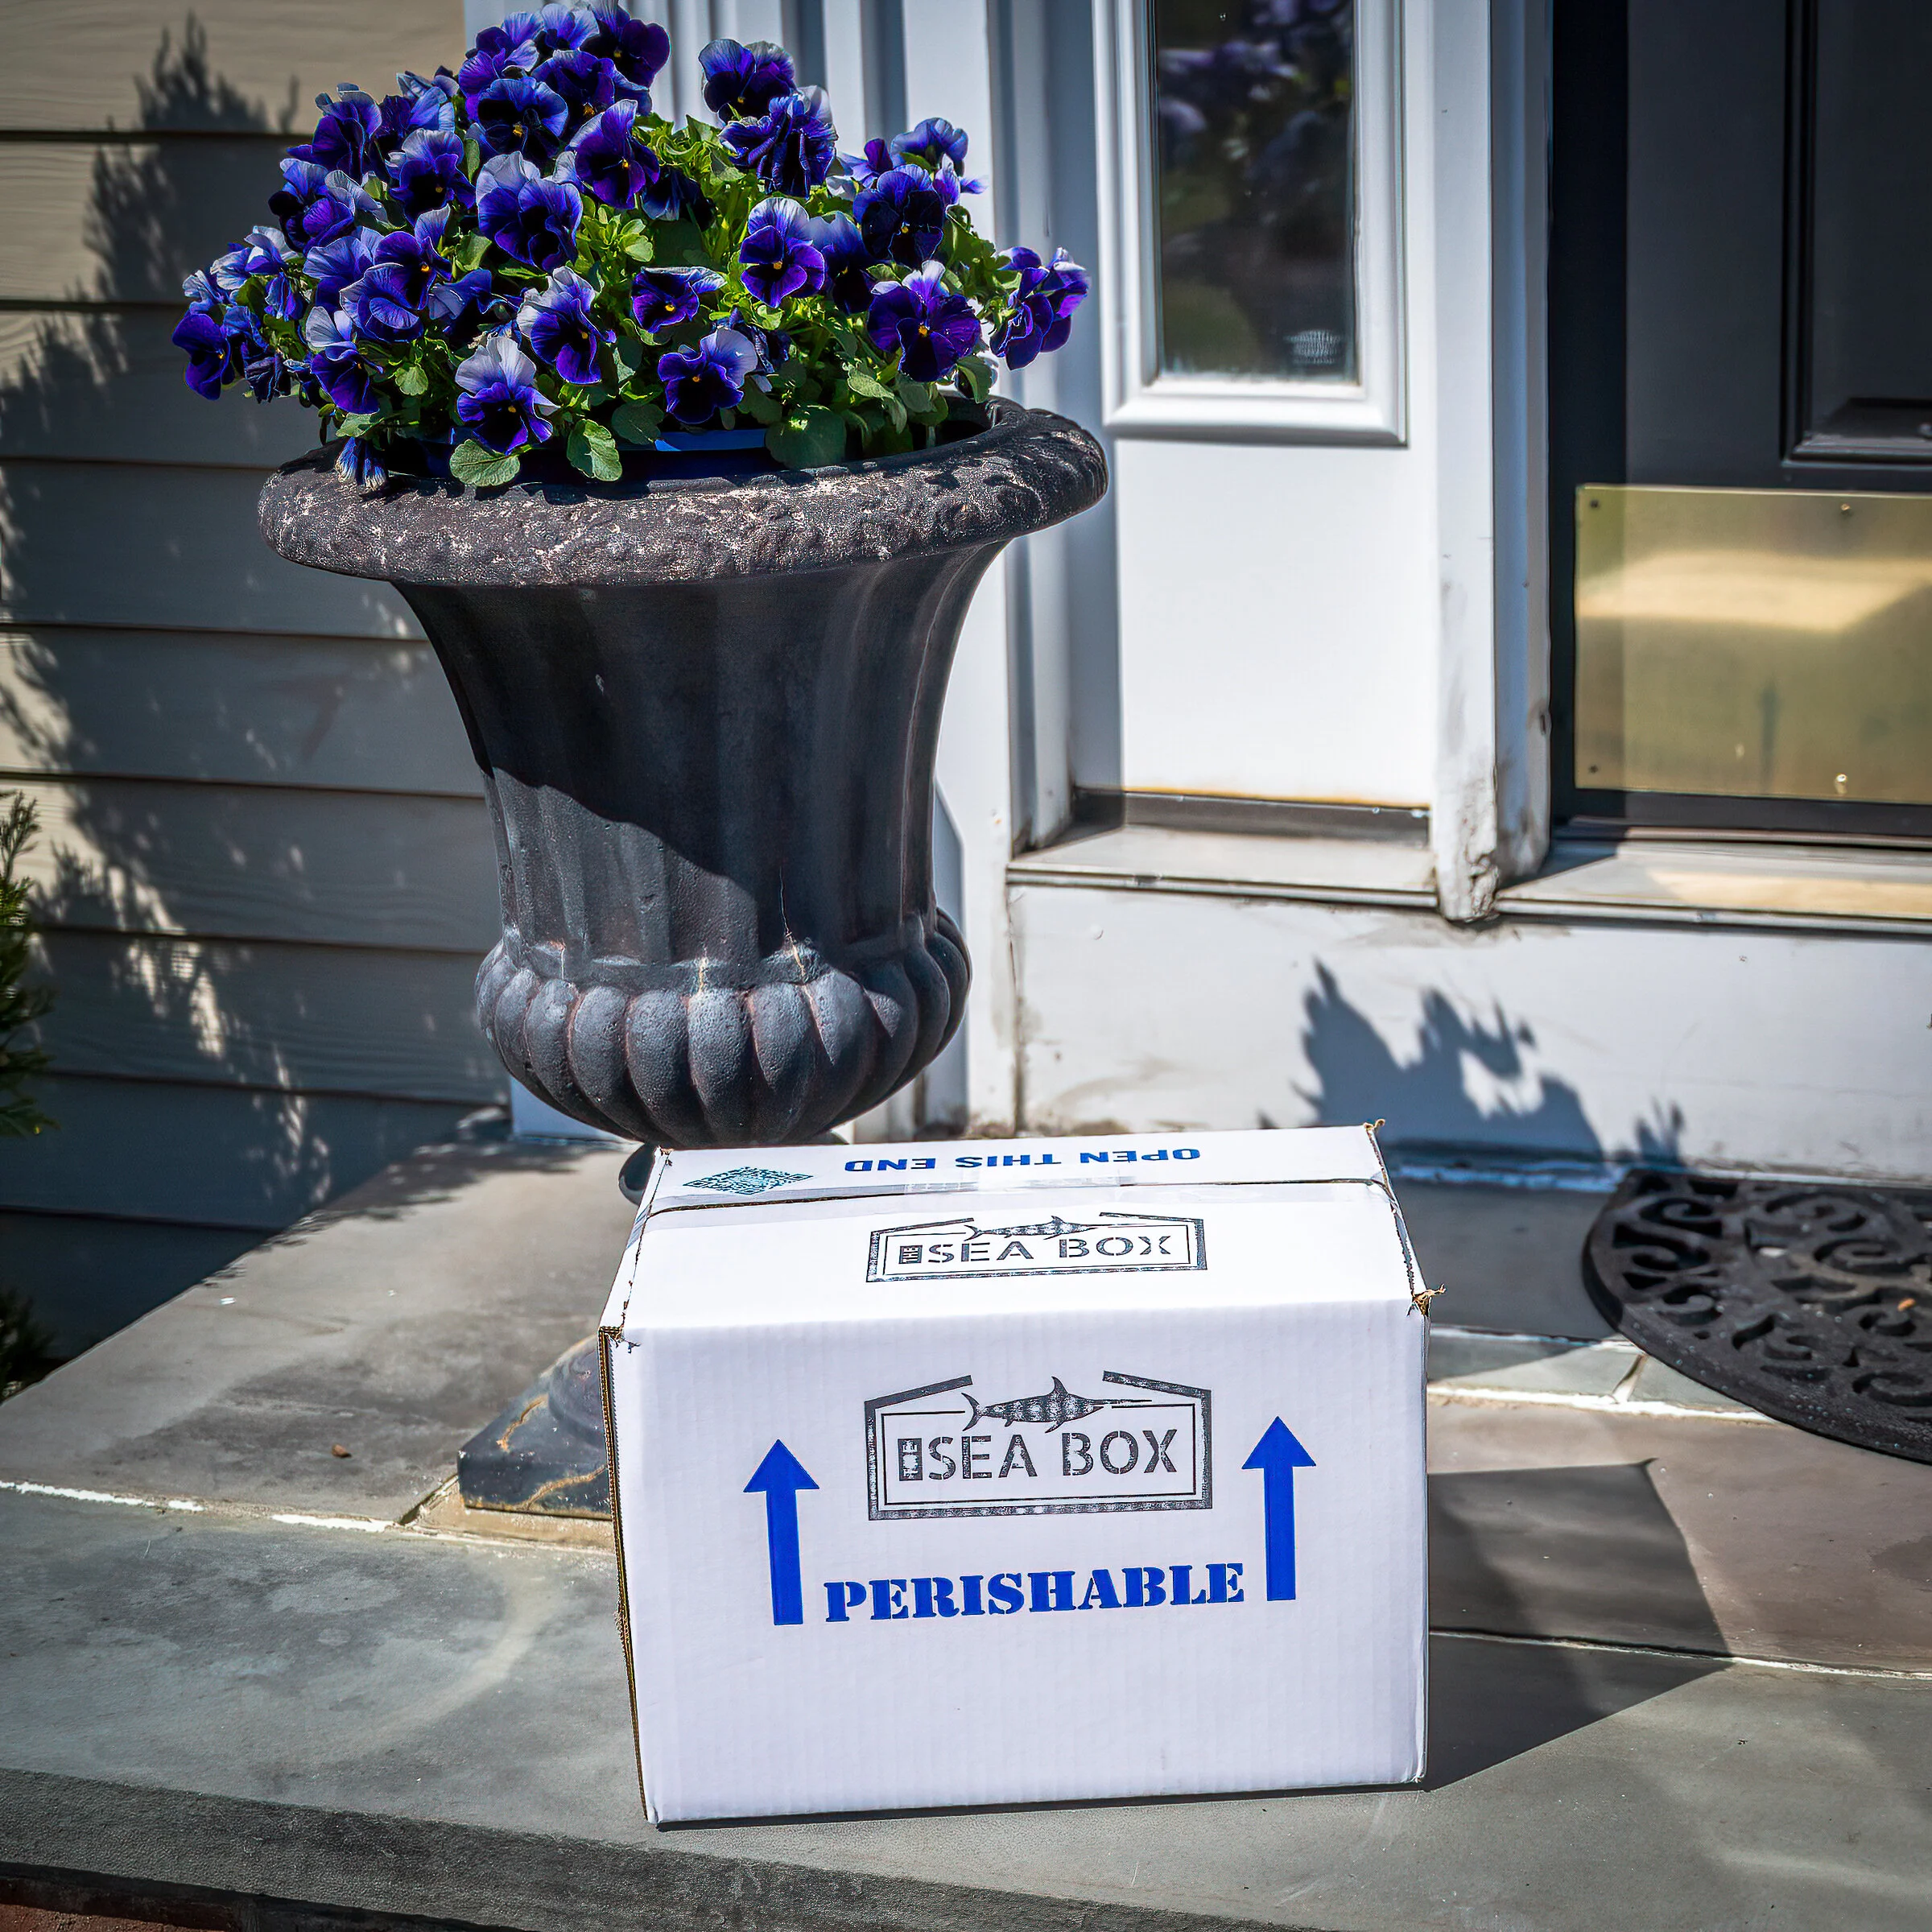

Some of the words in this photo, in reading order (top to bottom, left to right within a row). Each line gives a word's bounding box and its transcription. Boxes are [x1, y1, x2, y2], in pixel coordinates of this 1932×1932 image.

[844, 1158, 936, 1172] END
[955, 1154, 1061, 1168] THIS
[1080, 1149, 1200, 1164] OPEN
[927, 1241, 1034, 1263] SEA
[1059, 1236, 1171, 1257] BOX
[928, 1435, 1038, 1480] SEA
[1063, 1429, 1178, 1476] BOX
[824, 1563, 1245, 1622] PERISHABLE
